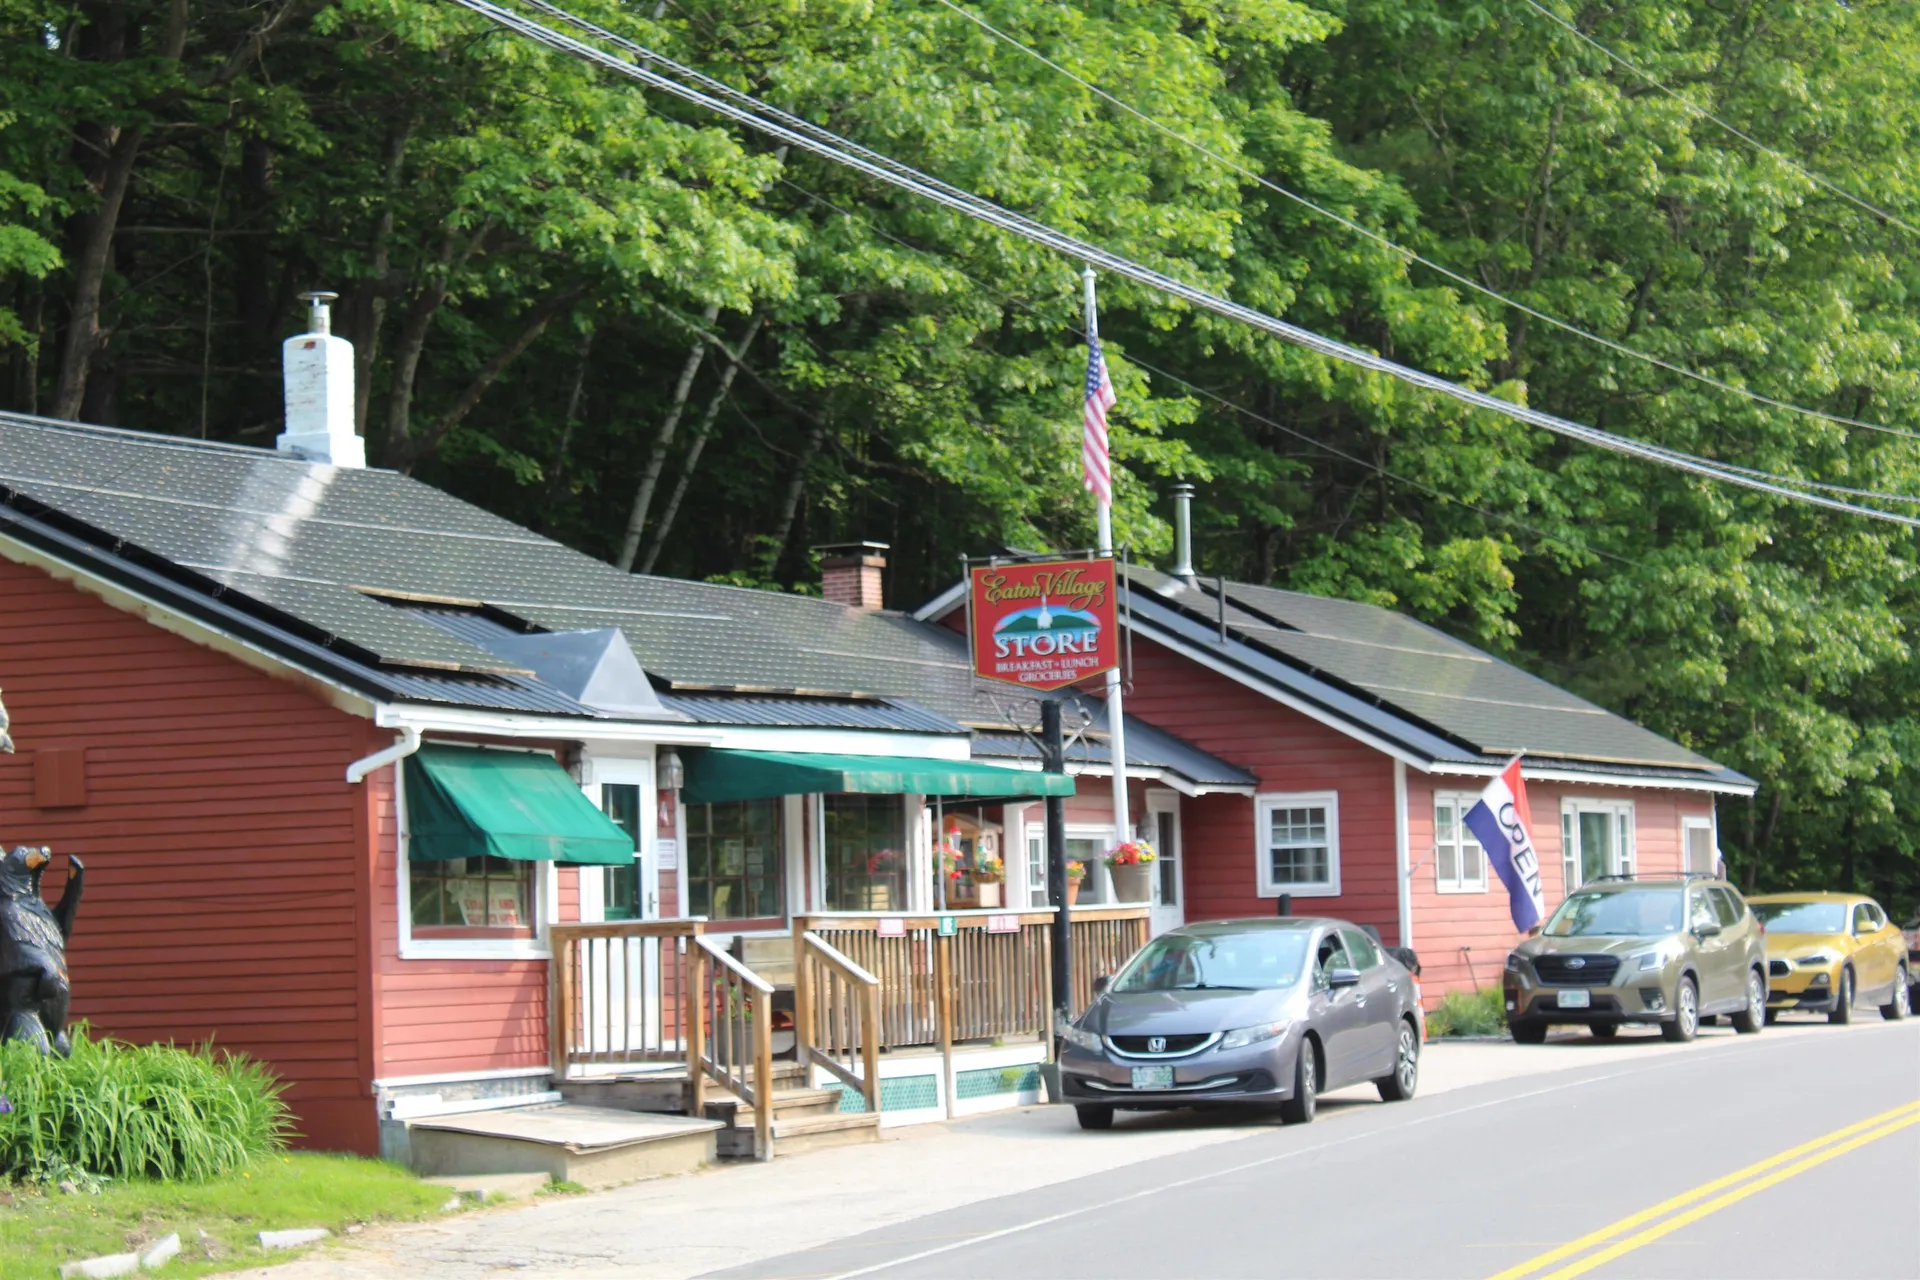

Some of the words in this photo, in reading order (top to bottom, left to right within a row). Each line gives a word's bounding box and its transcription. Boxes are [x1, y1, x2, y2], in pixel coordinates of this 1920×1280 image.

[980, 570, 1042, 606] Eaton
[1033, 568, 1107, 611] Village
[994, 631, 1098, 659] STORE
[995, 659, 1055, 673] BREAKFAST
[1060, 656, 1099, 670] LUNCH
[1018, 669, 1078, 683] GROCERIES
[1499, 802, 1542, 897] OPEN
